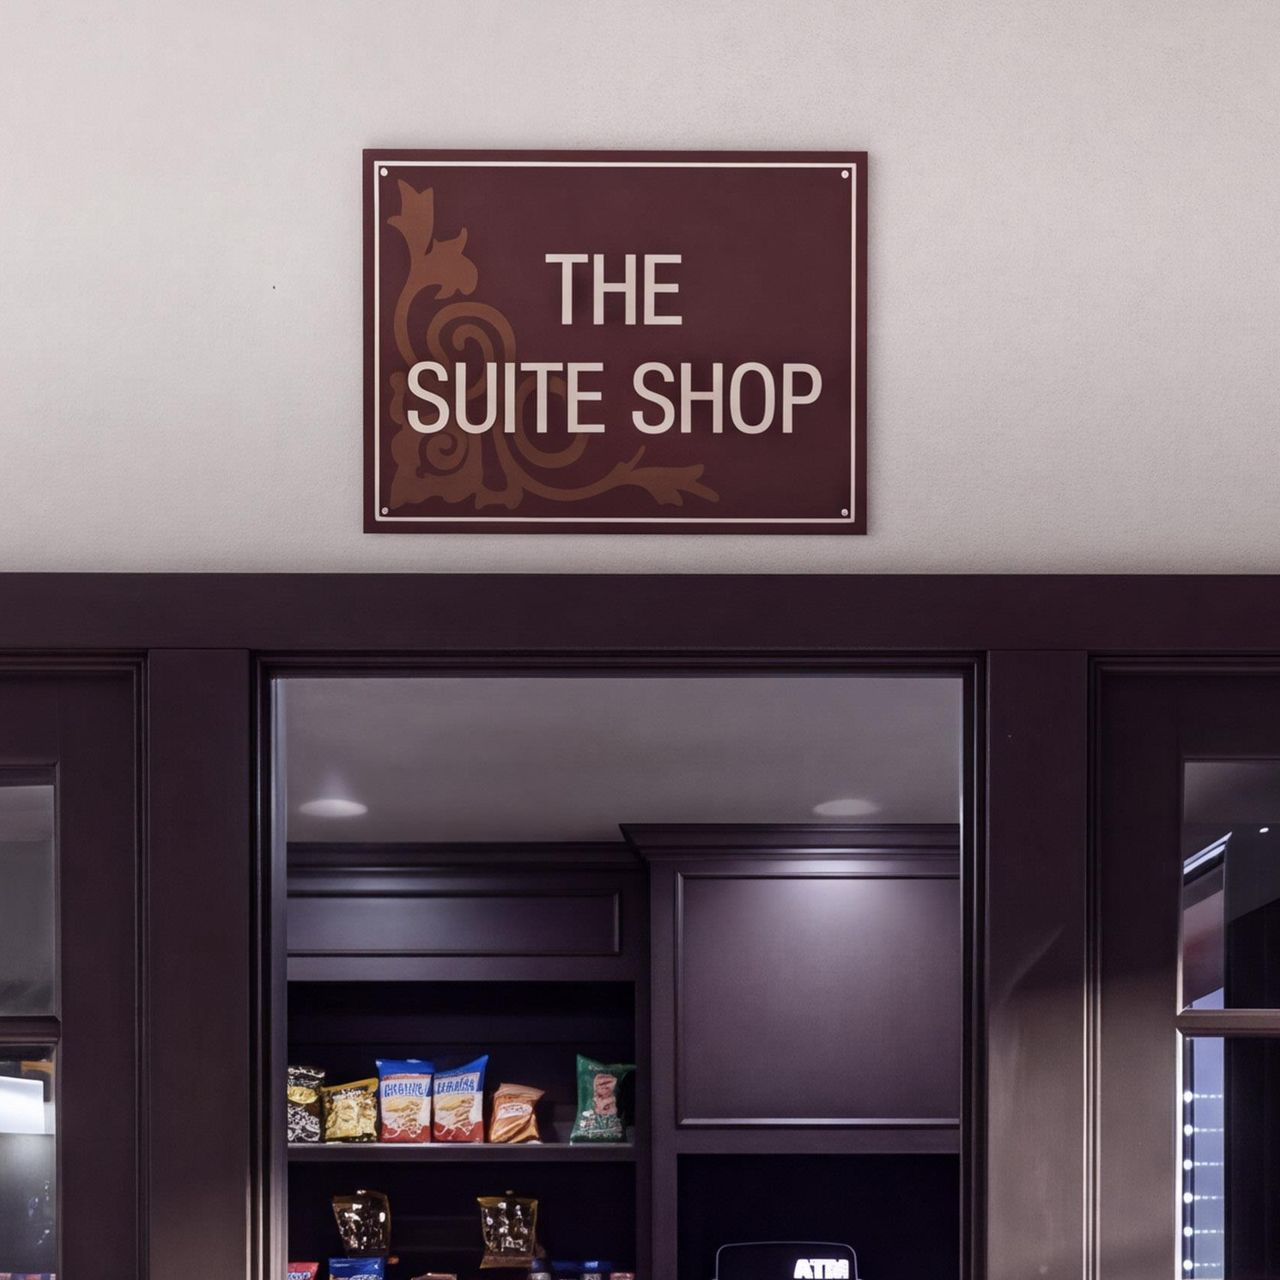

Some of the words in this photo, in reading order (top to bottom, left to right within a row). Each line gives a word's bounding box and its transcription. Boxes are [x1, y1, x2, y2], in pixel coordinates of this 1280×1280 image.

[545, 253, 683, 325] THE
[407, 361, 605, 434] SUITE
[632, 361, 822, 435] SHOP
[793, 1258, 849, 1280] ATM
